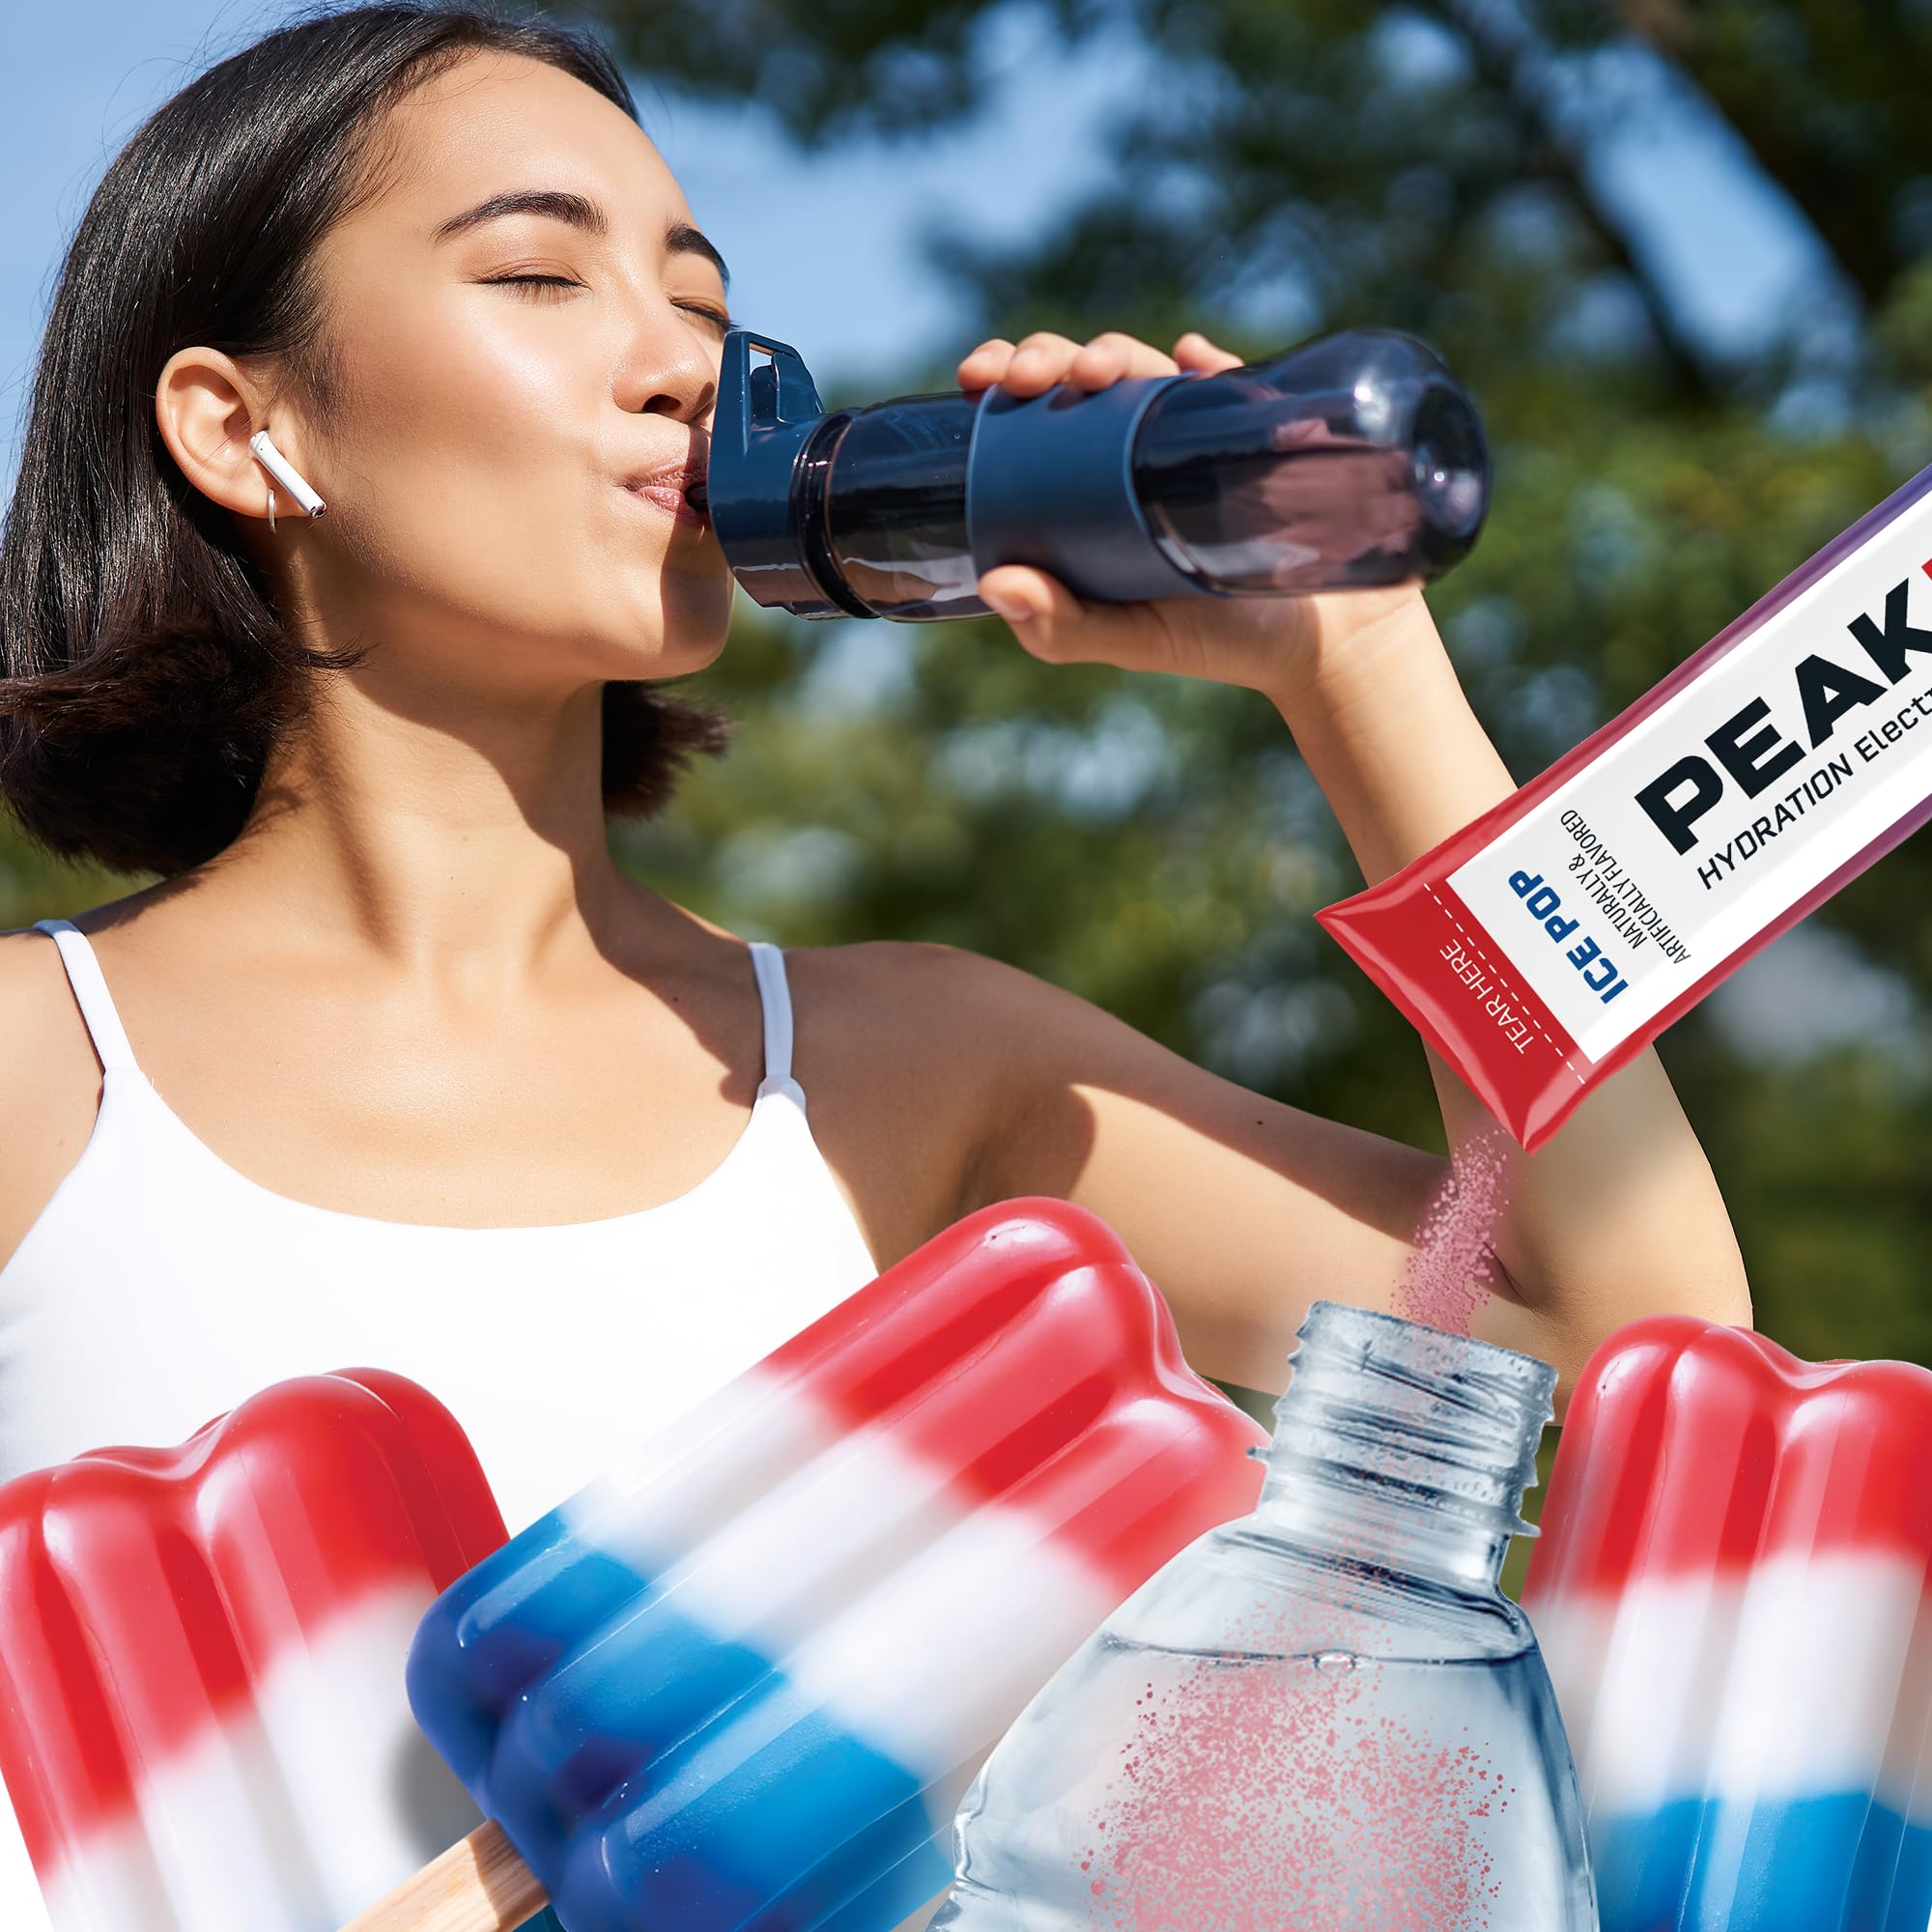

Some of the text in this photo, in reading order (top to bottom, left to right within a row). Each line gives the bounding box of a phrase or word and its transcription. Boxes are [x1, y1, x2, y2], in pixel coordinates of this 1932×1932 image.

[1634, 578, 1932, 856] PEAK
[1697, 687, 1932, 890] HYDRATION Elect
[1508, 870, 1629, 1004] ICE POP
[1560, 810, 1691, 964] ARTIFICIALLY FLAVORED
[1569, 853, 1648, 949] NATURALLY &
[1439, 939, 1534, 1055] TEAR HERE
